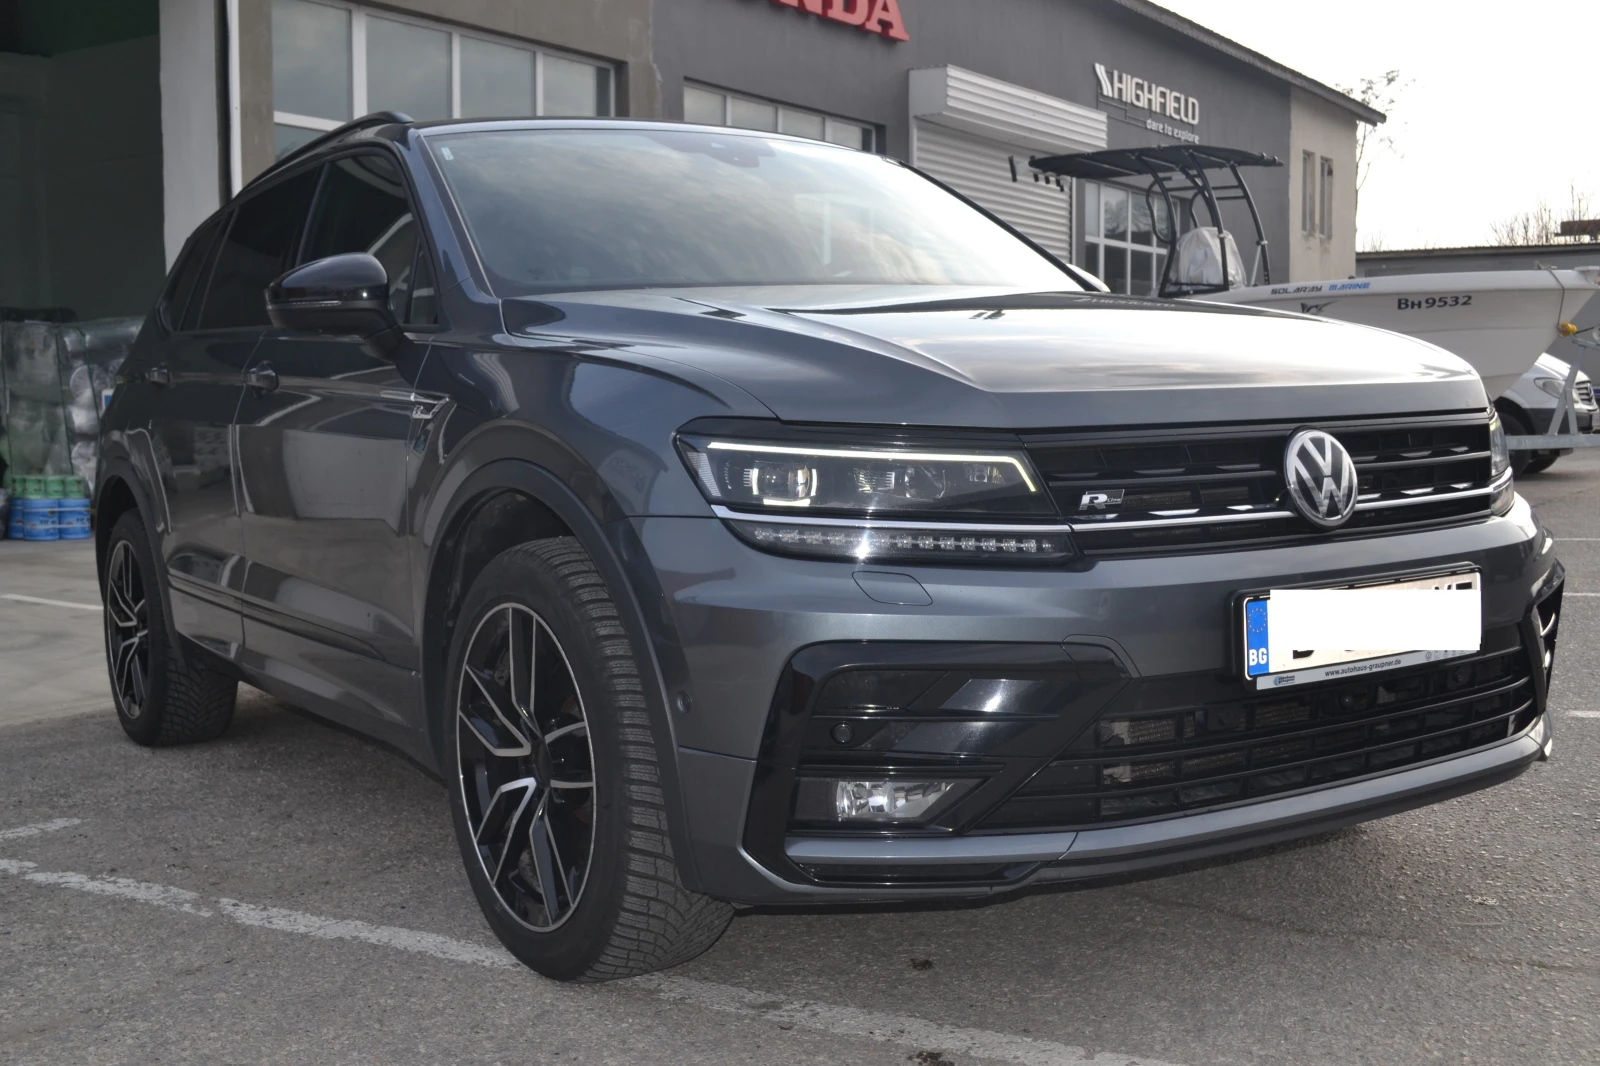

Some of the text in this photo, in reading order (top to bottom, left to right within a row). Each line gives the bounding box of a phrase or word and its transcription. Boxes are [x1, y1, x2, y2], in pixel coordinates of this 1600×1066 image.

[1112, 69, 1199, 125] HIGHFIELD
[1146, 118, 1200, 145] dare to explore
[1328, 282, 1371, 291] MARINE
[1424, 294, 1472, 309] 9532
[1249, 647, 1268, 666] BG
[1324, 658, 1402, 677] www.autohaus-graupner.de
